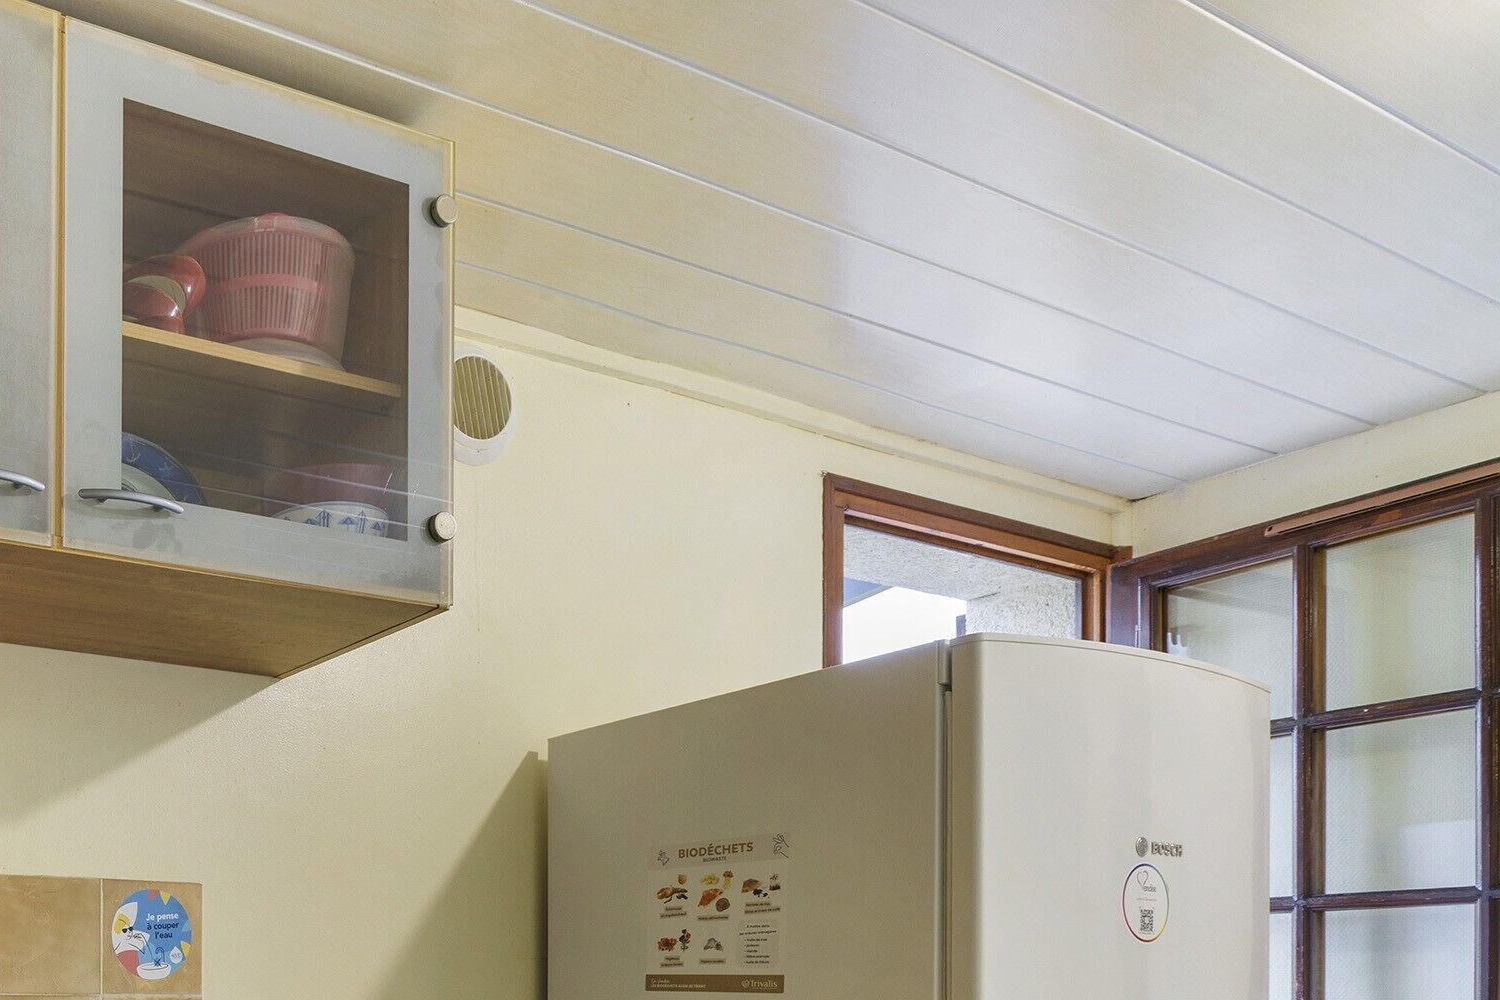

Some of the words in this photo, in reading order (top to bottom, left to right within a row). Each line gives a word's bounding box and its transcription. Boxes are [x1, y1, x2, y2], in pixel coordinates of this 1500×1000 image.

[678, 842, 754, 859] BIODÉCHETS
[1151, 841, 1183, 858] BOSCH
[146, 913, 155, 921] Je
[157, 913, 180, 922] pense
[147, 922, 152, 931] à
[153, 922, 180, 931] couper
[155, 931, 173, 939] l'eau
[750, 979, 778, 989] Trivalis
